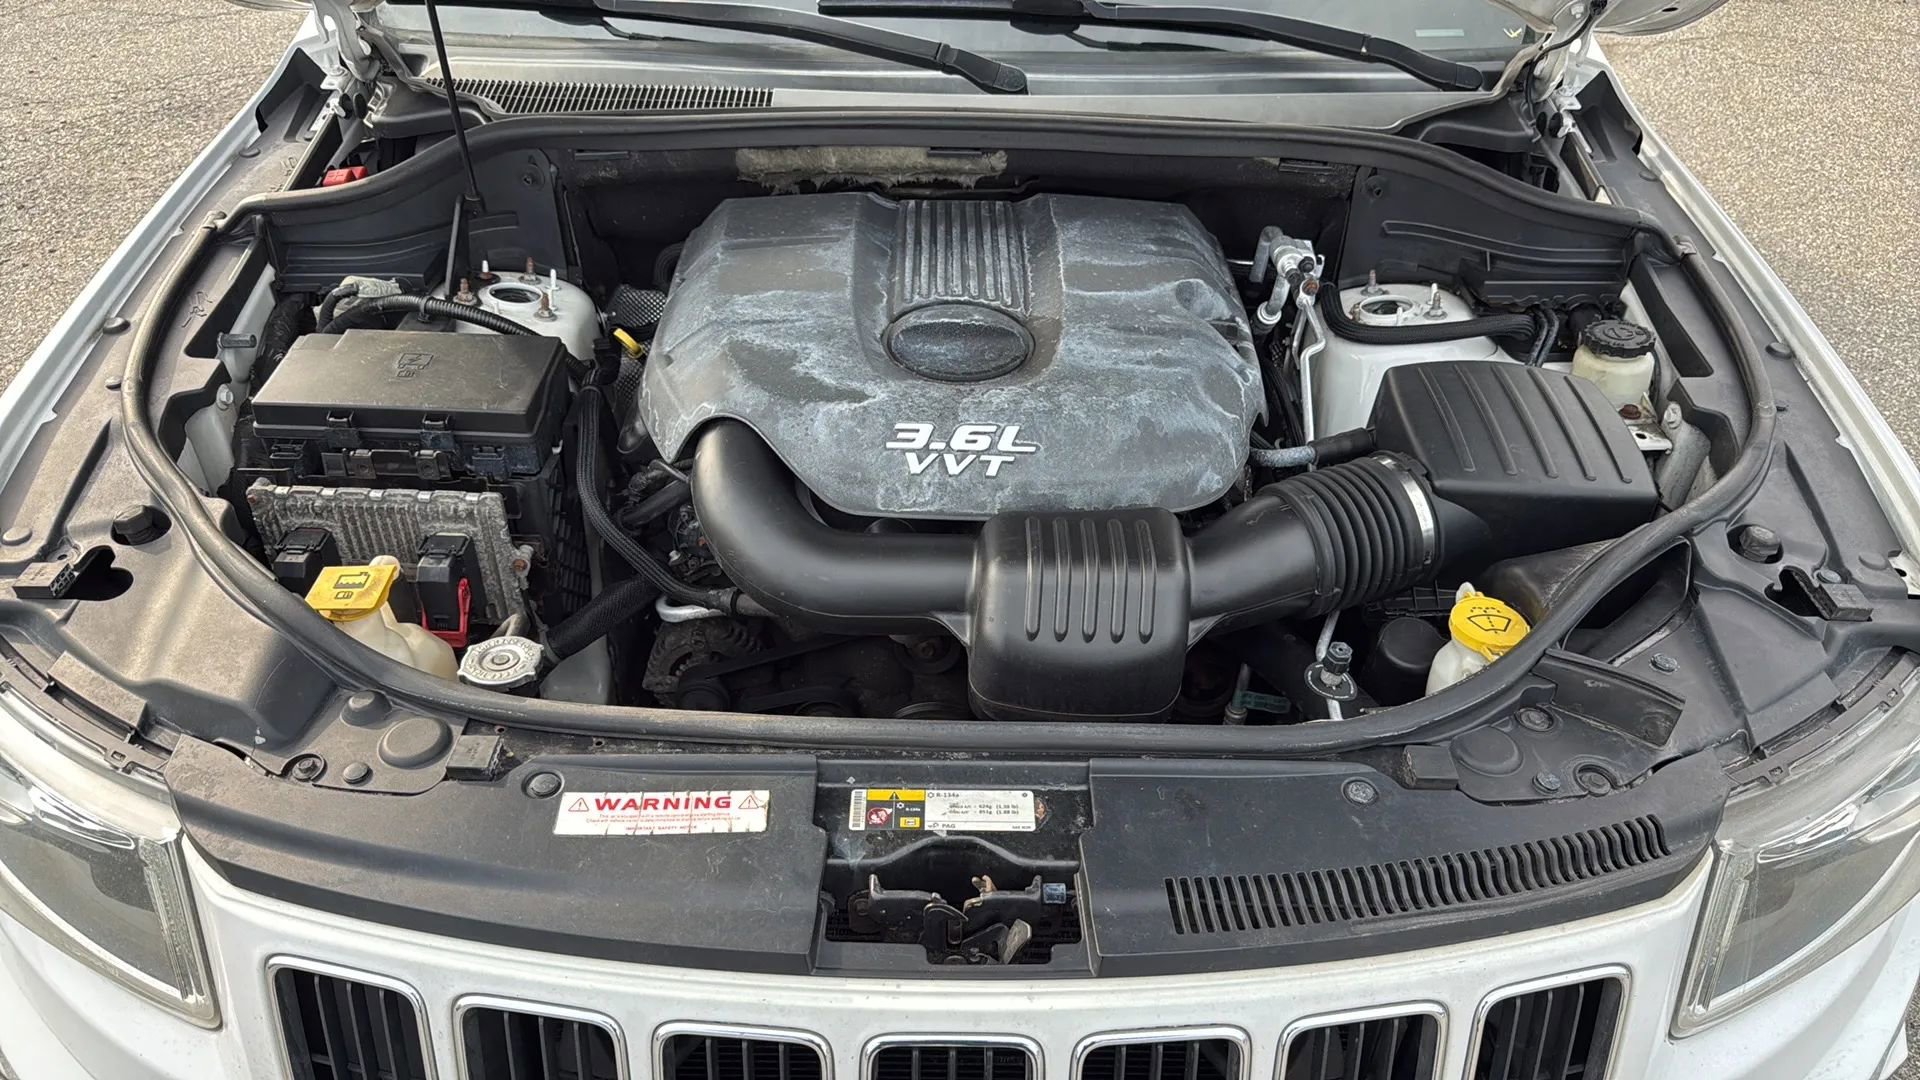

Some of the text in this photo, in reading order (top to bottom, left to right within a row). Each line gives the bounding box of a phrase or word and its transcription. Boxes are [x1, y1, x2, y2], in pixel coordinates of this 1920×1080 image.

[885, 423, 1037, 453] 3.6L
[904, 452, 1016, 477] VVT
[594, 796, 732, 811] WARNING
